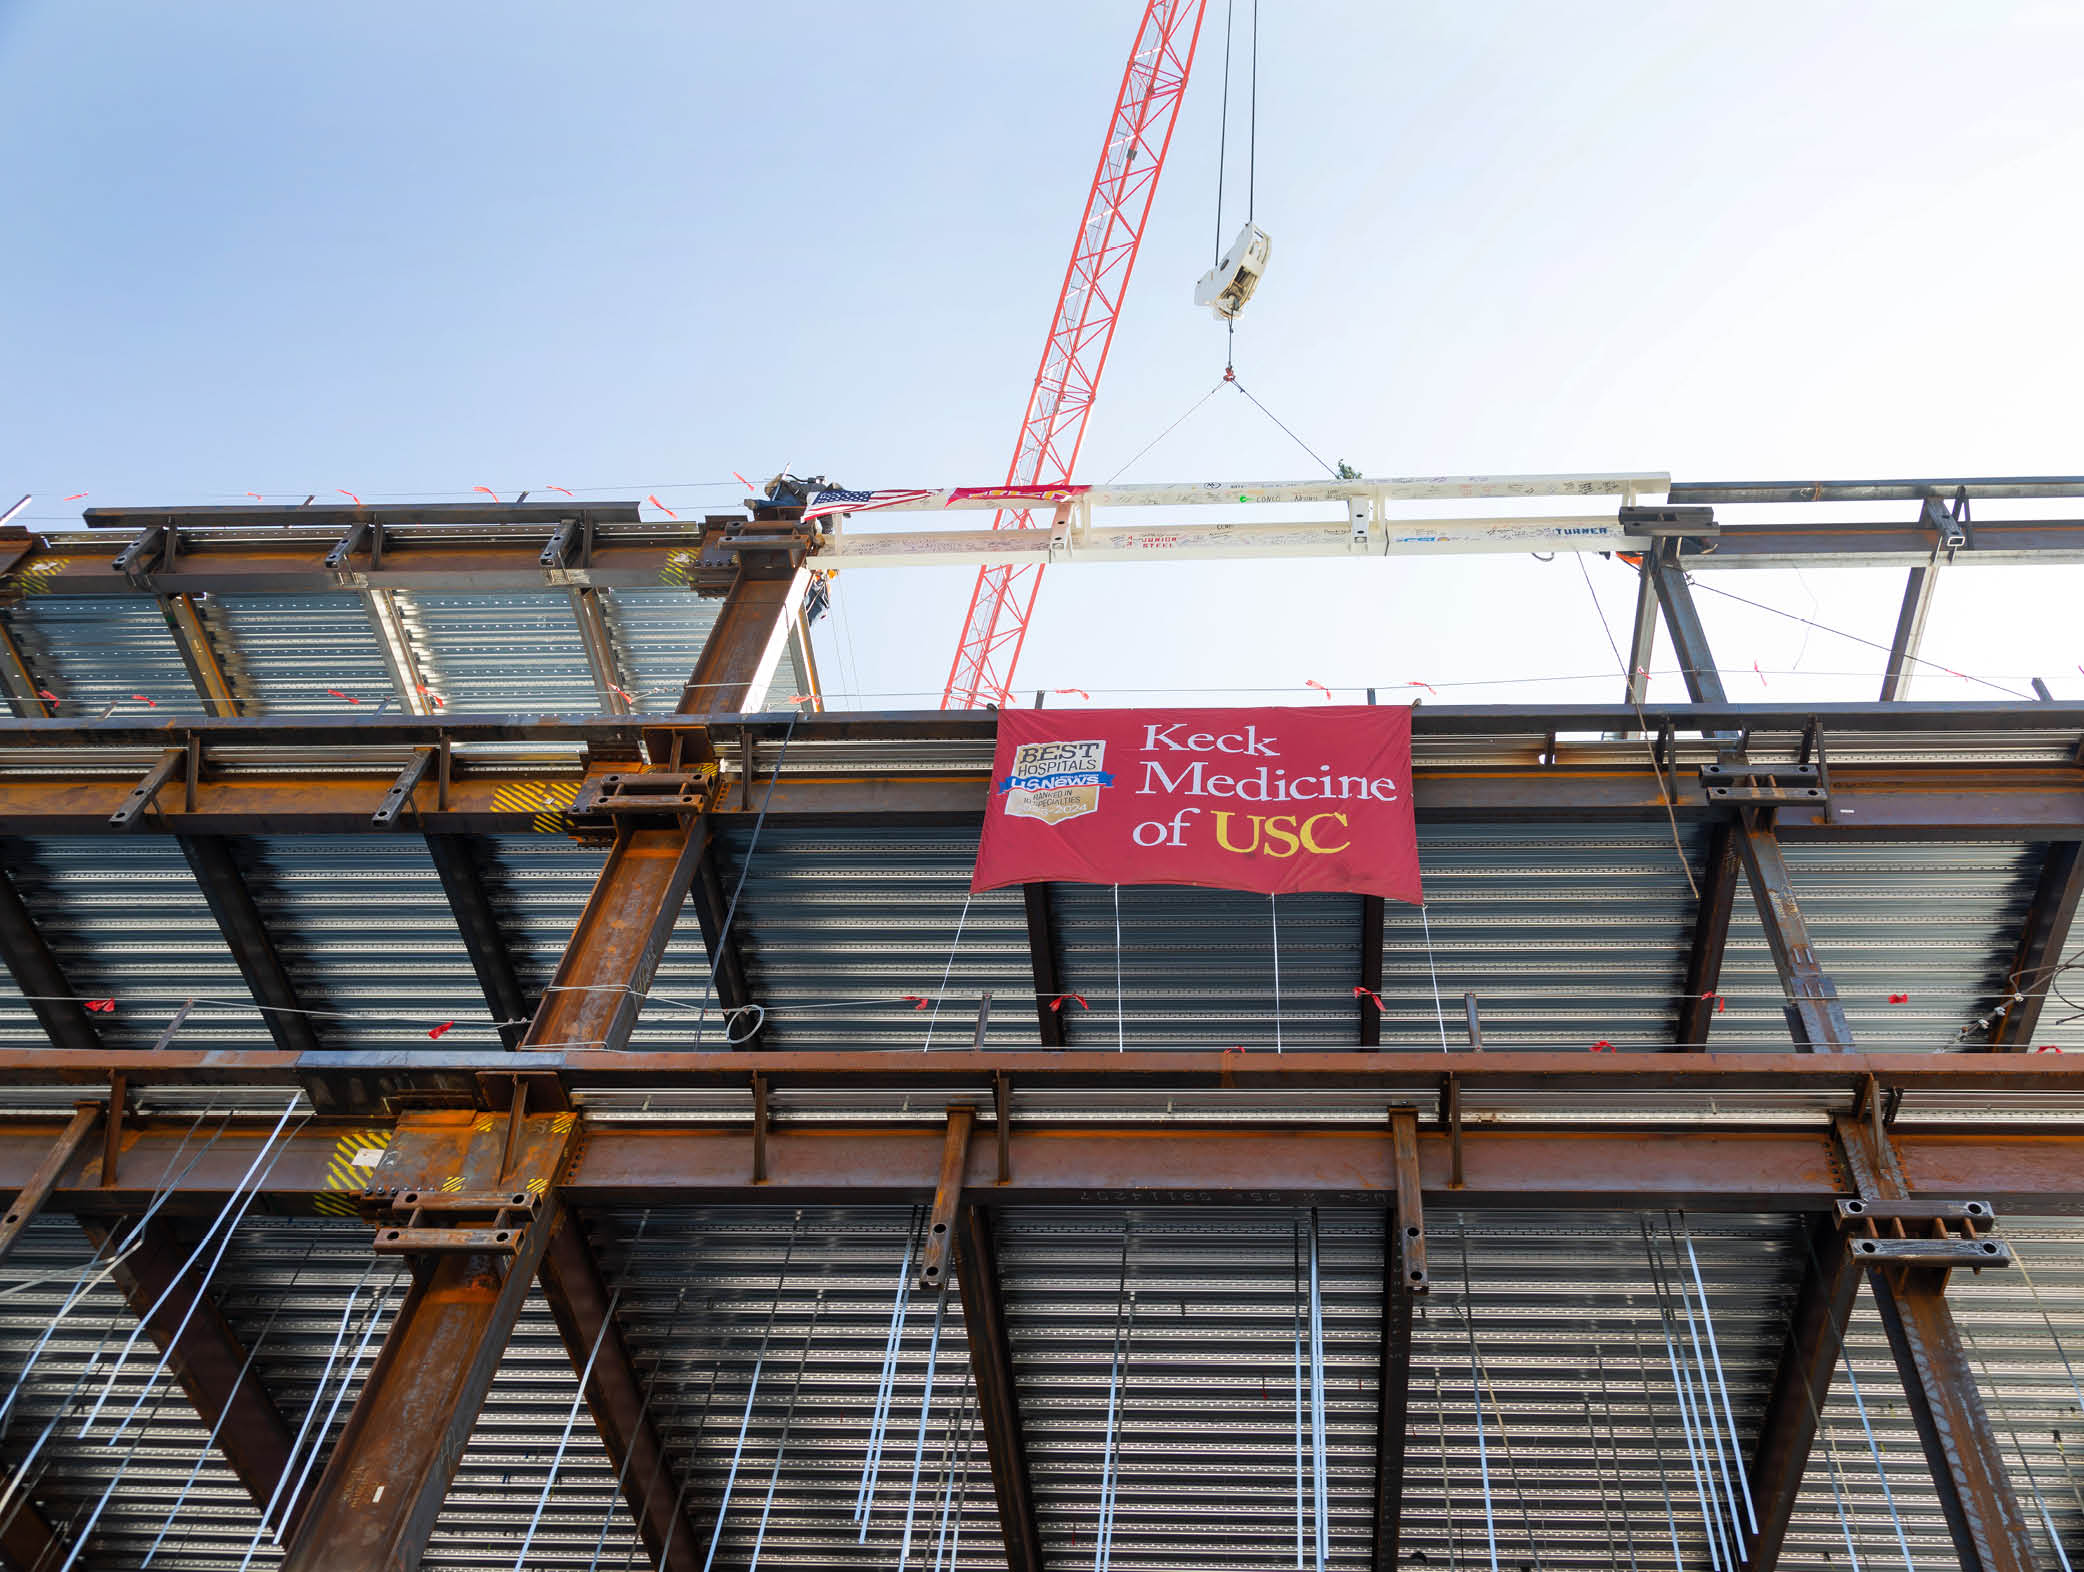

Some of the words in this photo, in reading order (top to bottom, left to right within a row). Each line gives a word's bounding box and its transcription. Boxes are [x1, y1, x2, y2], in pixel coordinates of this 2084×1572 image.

[1555, 527, 1608, 535] TURNER
[1140, 723, 1281, 756] Keck
[1020, 743, 1099, 763] BEST
[1018, 760, 1097, 776] HOSPITALS
[1135, 761, 1397, 801] Medicine
[1033, 790, 1063, 800] RANKED
[1064, 789, 1073, 797] IN
[1132, 807, 1201, 847] of
[1210, 810, 1351, 858] USC
